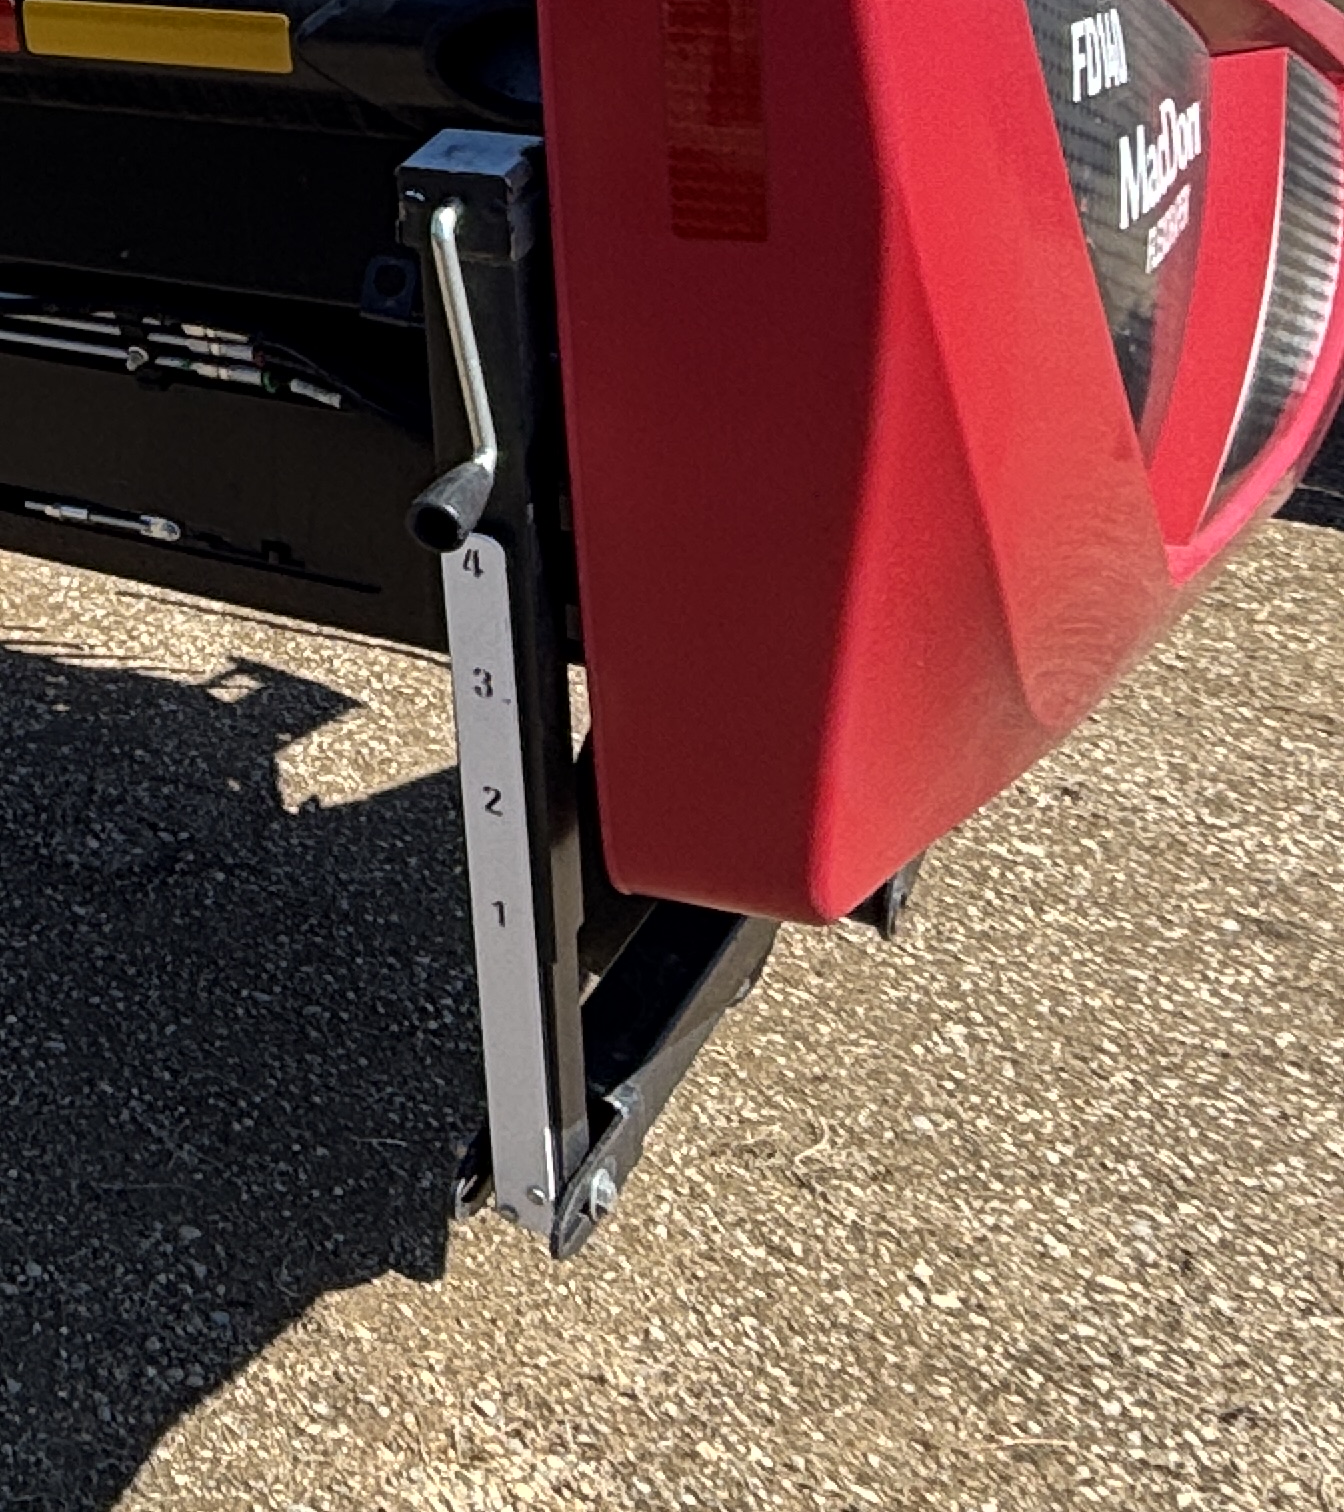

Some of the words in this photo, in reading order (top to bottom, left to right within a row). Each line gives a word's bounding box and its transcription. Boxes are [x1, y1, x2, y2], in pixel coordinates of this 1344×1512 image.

[1118, 98, 1201, 230] MacDon
[462, 549, 484, 579] 4
[472, 667, 493, 698] 3
[482, 786, 503, 816] 2
[492, 900, 506, 928] 1
